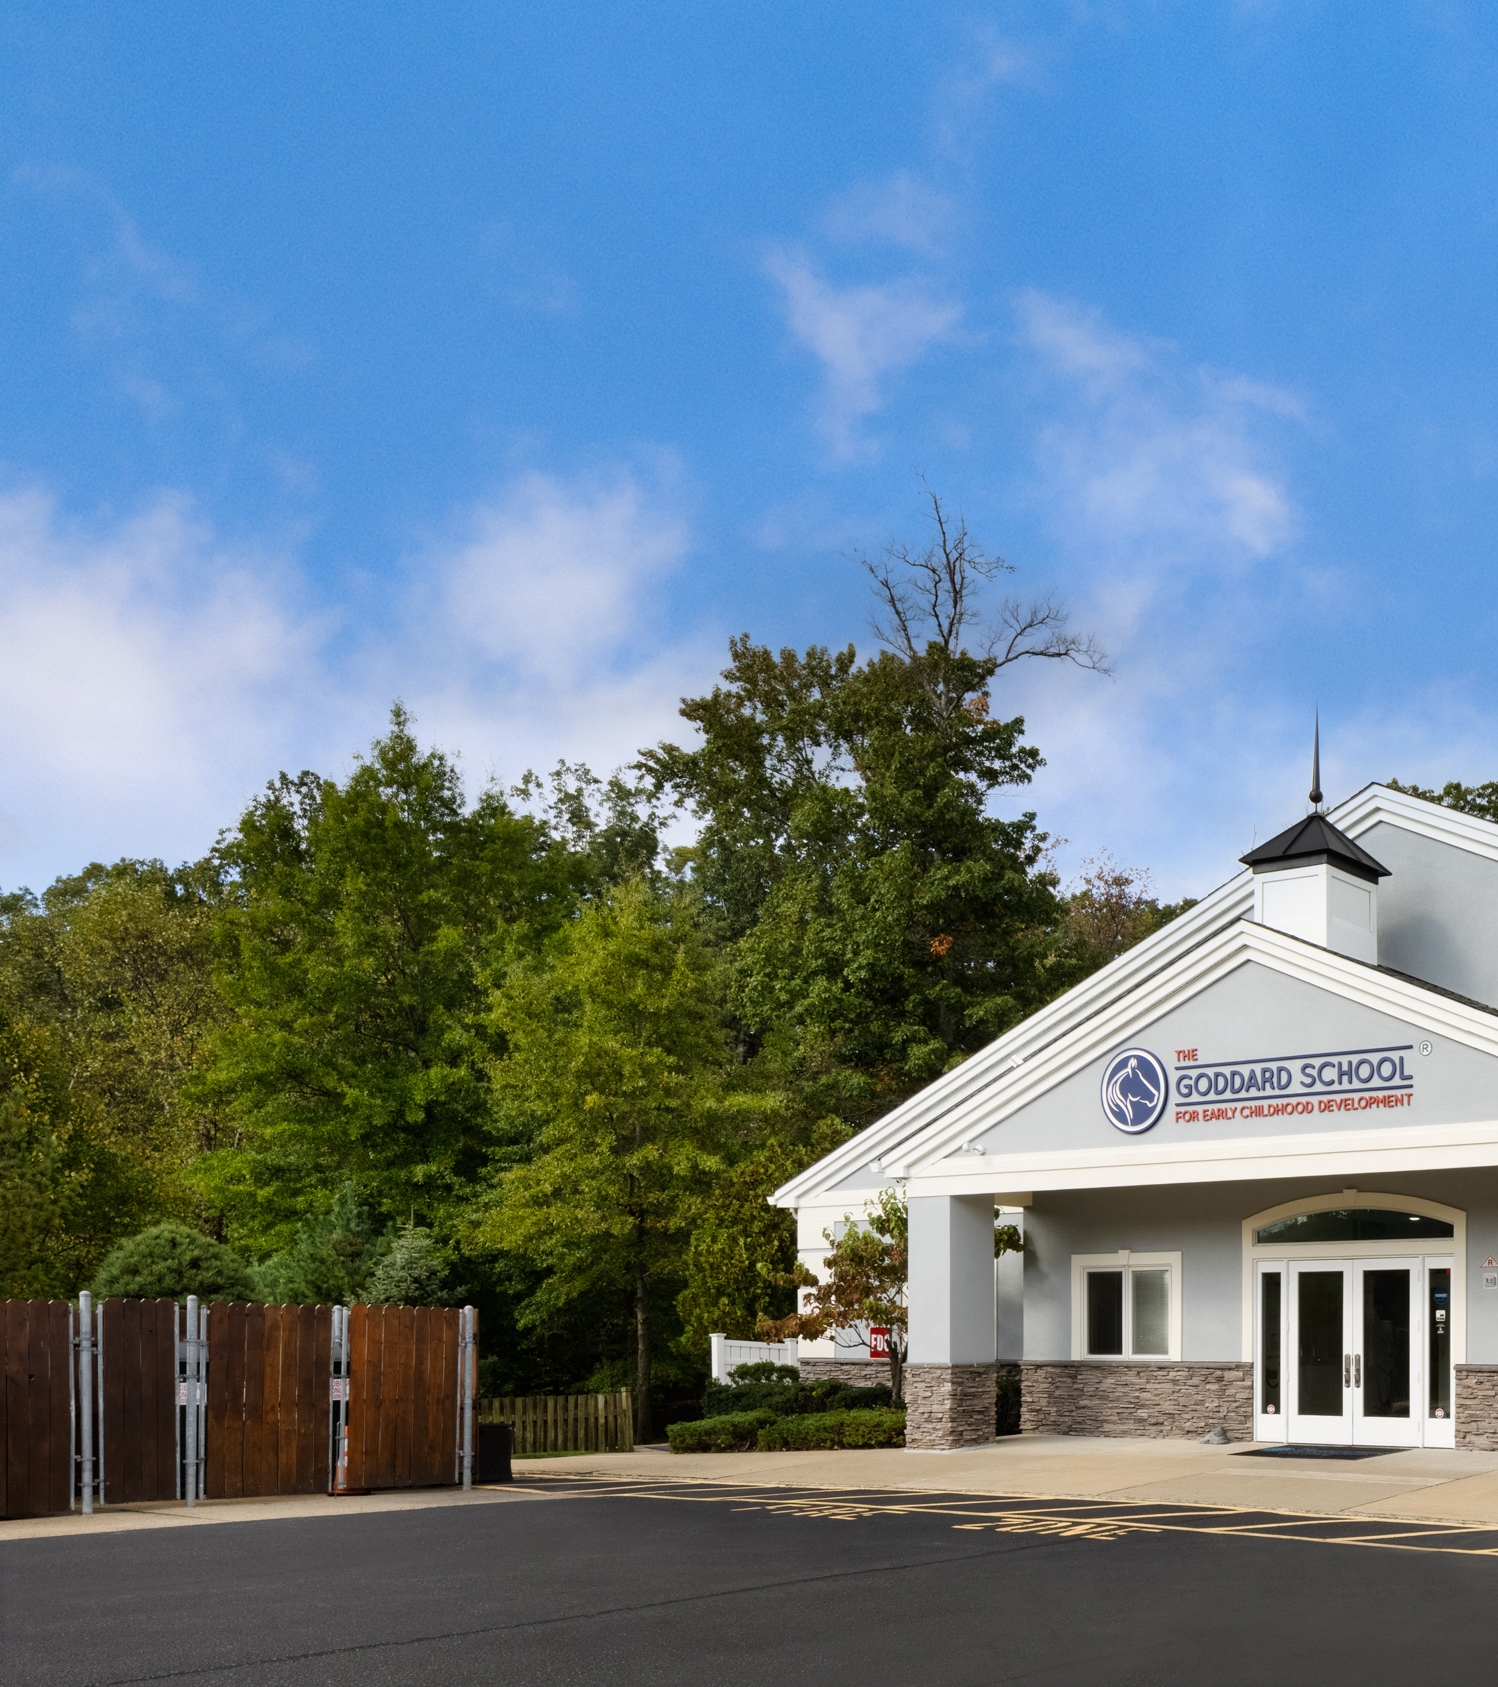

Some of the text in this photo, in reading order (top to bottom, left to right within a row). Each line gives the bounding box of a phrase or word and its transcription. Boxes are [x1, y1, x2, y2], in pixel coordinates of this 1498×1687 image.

[1174, 1048, 1198, 1062] THE
[1175, 1056, 1413, 1098] GODDARD SCHOOL
[1174, 1093, 1414, 1123] FOR EARLY CHILDHOOD DEVELOPMENT
[730, 1503, 1163, 1541] FIRE ZONE
